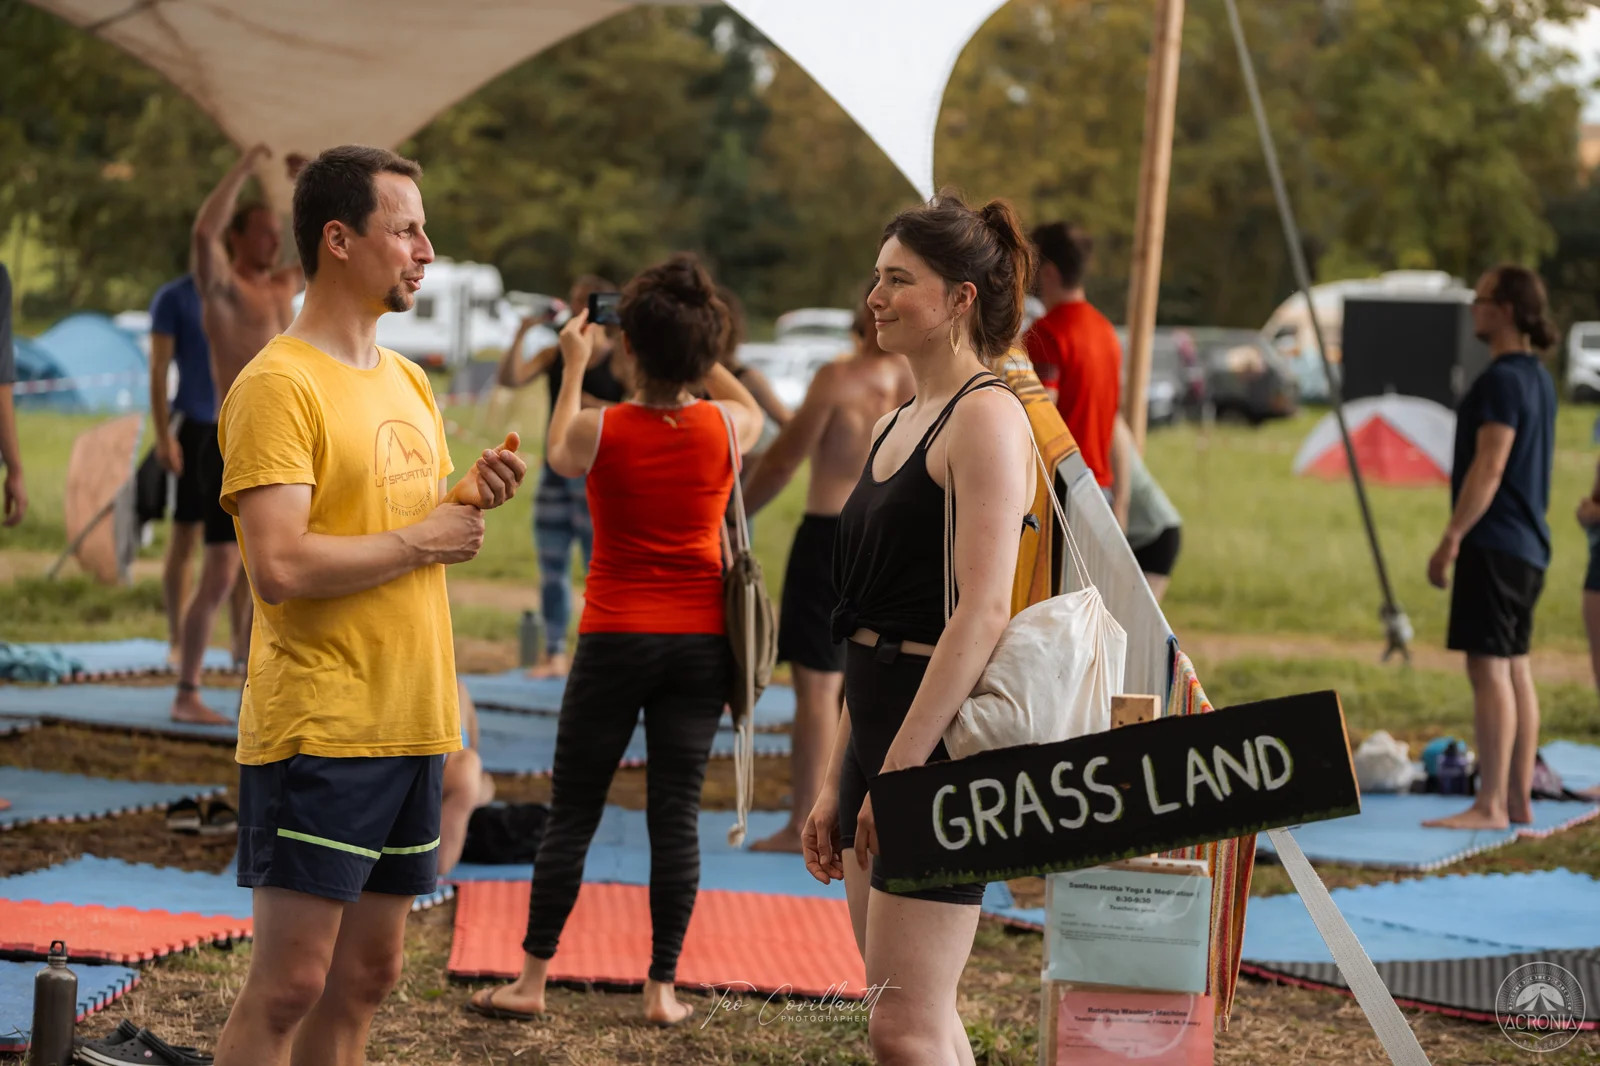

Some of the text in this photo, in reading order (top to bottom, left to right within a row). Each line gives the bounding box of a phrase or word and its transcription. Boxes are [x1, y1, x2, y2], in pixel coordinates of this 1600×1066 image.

[388, 467, 433, 485] SPORTIVA
[932, 734, 1294, 851] GRASS LAND
[1099, 884, 1123, 892] Hatha
[1125, 886, 1144, 895] Yoga
